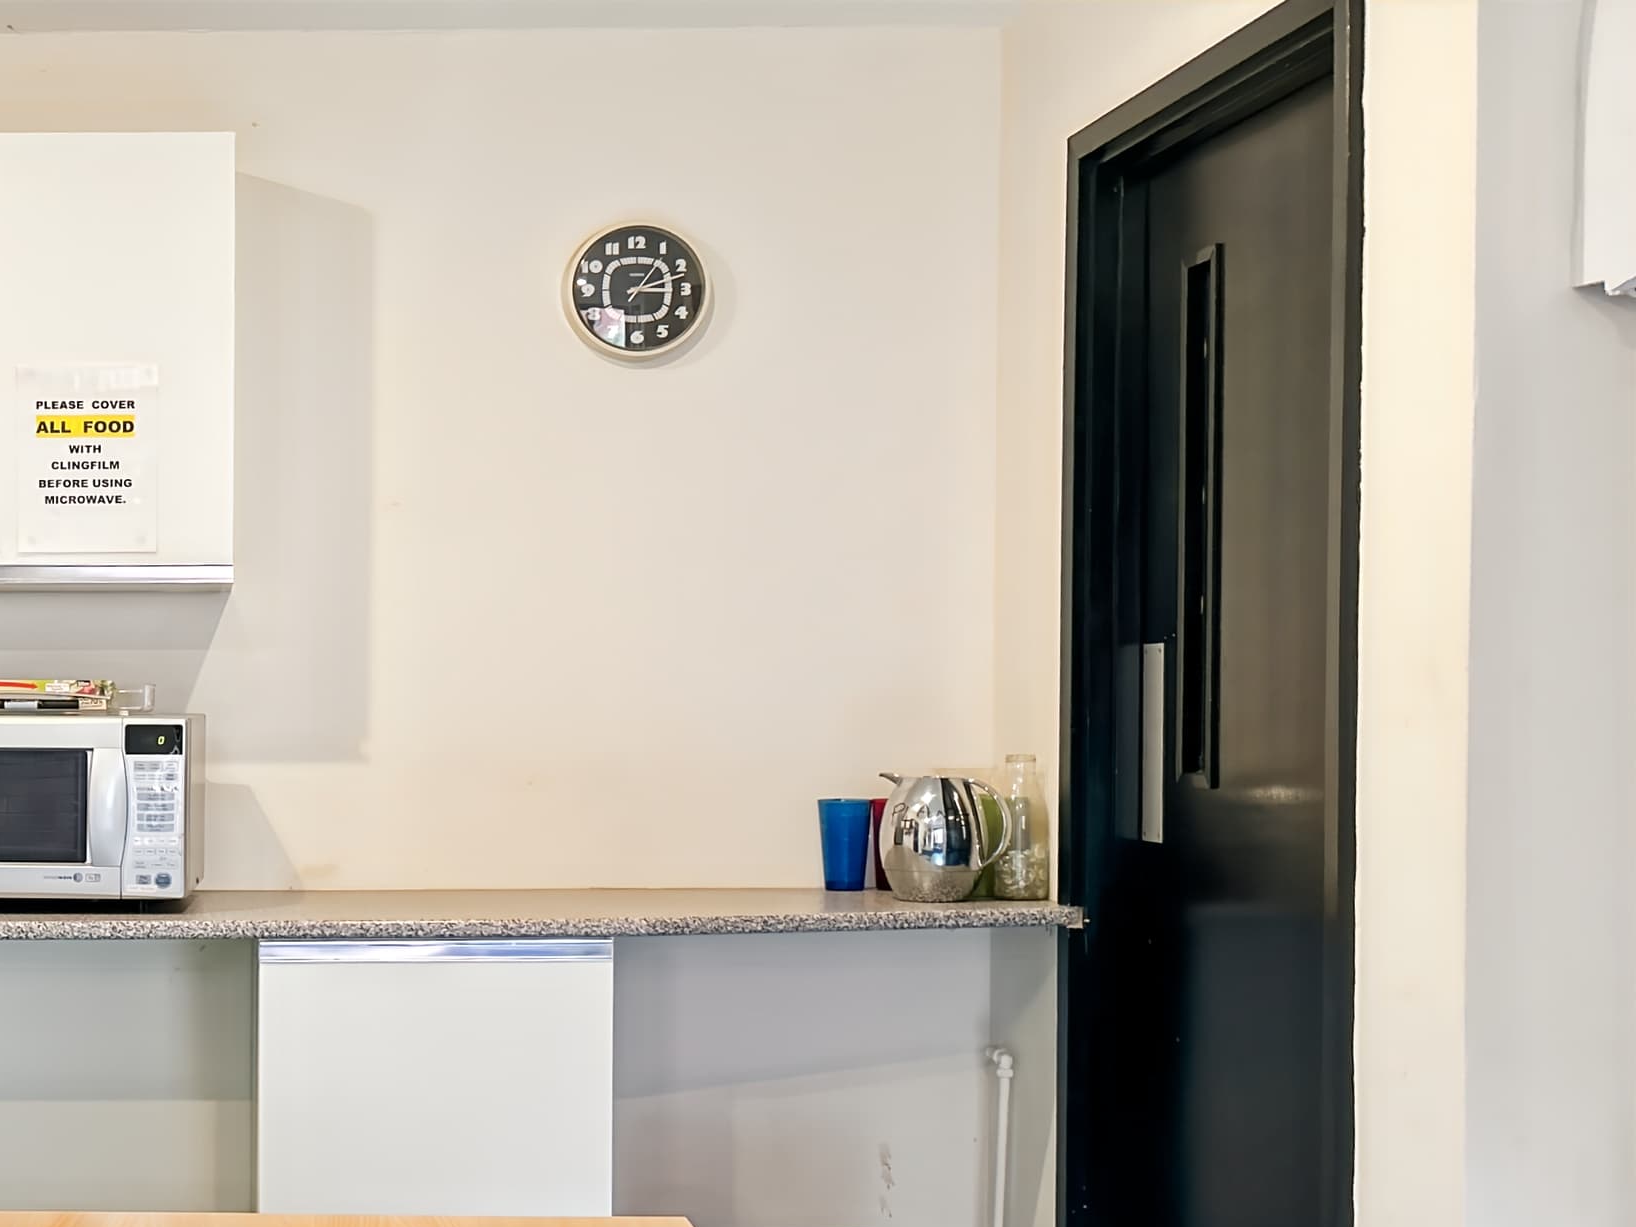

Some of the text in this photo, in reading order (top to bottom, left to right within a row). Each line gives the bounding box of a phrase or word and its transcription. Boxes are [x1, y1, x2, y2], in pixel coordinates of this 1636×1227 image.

[605, 242, 620, 256] 11
[627, 235, 646, 249] 12
[659, 240, 667, 255] 1
[580, 259, 603, 274] 10
[675, 258, 687, 273] 2
[580, 283, 595, 297] 9
[680, 282, 692, 296] 3
[587, 307, 601, 321] 8
[674, 306, 689, 320] 4
[630, 331, 645, 344] 6
[656, 325, 669, 338] 5
[35, 400, 136, 410] PLEASE COVER
[35, 420, 135, 434] ALL FOOD
[68, 444, 103, 454] WITH
[51, 460, 121, 470] CLINGFILM
[38, 478, 133, 489] BEFORE USING
[44, 495, 127, 505] MICROWAVE.
[157, 735, 166, 746] 0
